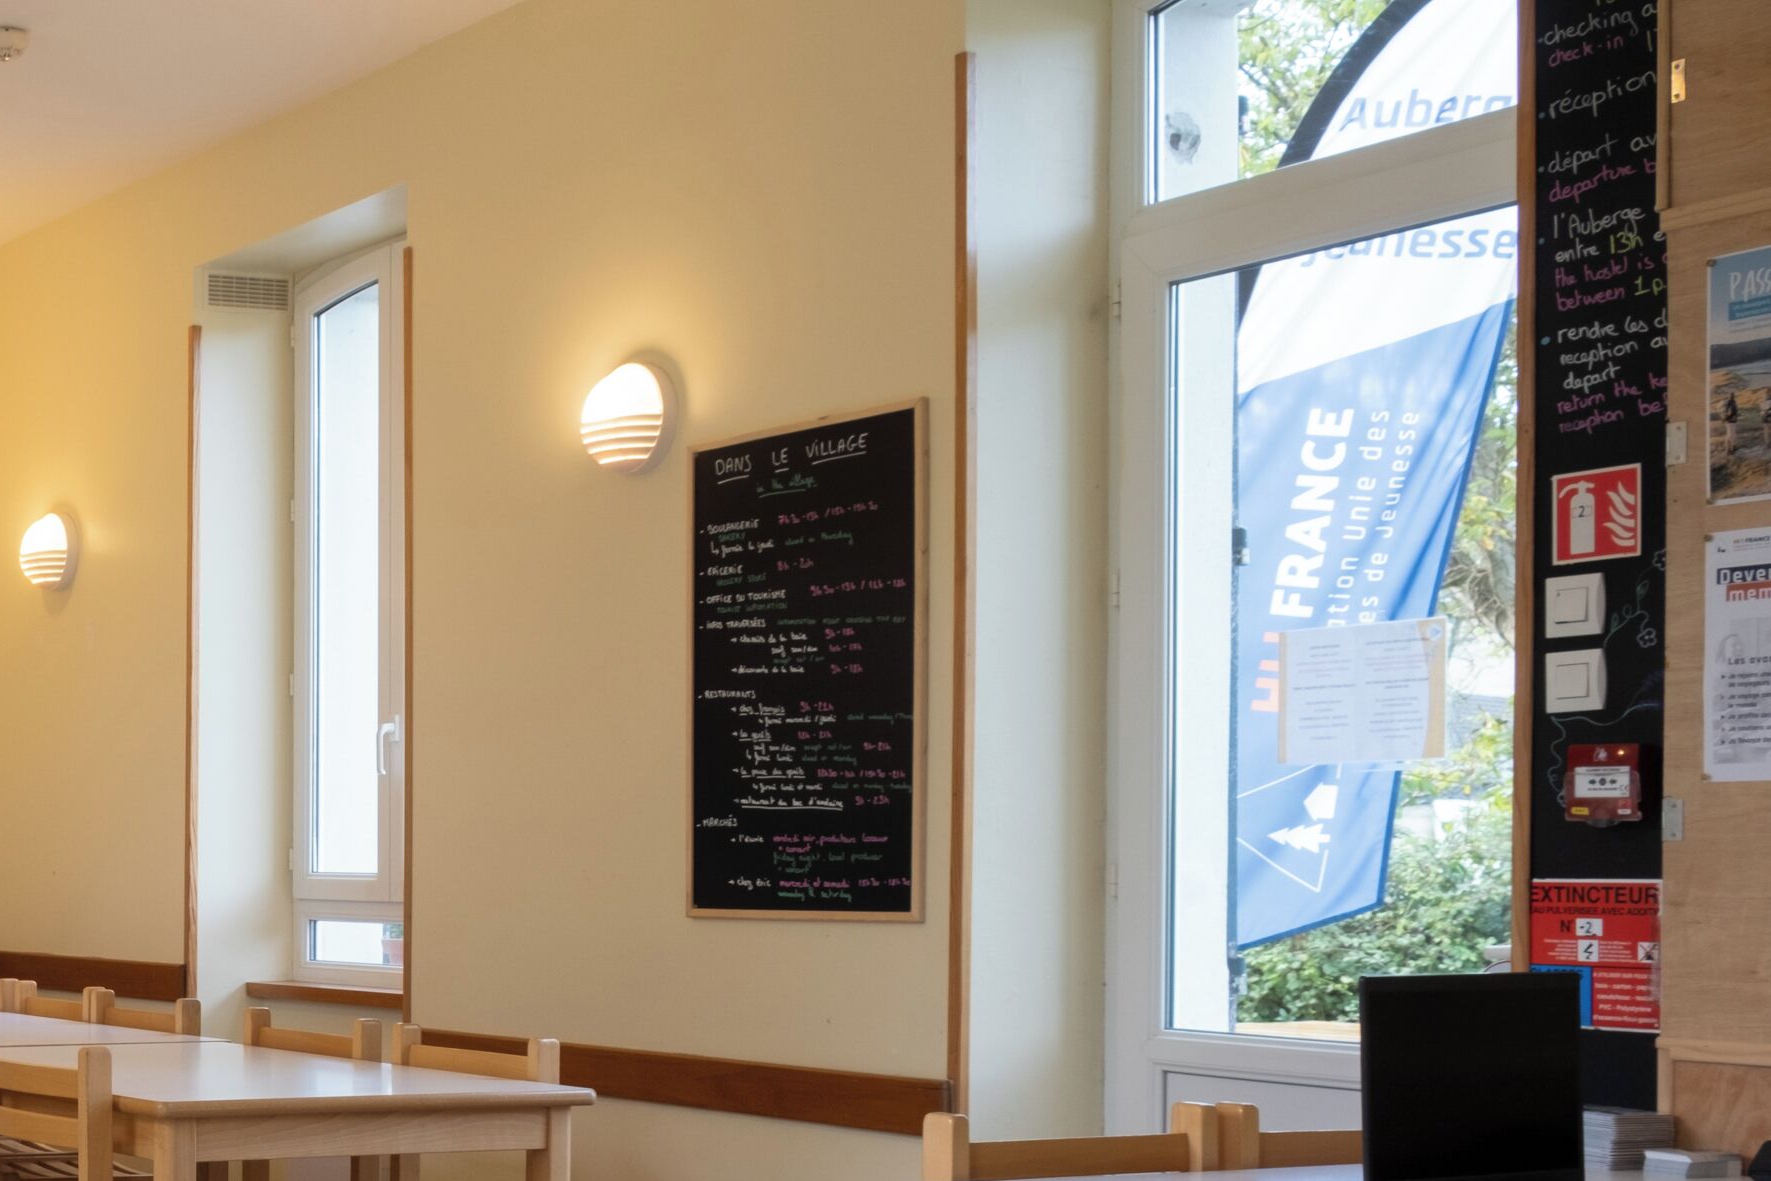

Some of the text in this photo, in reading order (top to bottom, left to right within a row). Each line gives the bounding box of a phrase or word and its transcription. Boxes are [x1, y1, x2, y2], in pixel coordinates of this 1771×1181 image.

[1544, 11, 1639, 45] checking
[1549, 36, 1623, 67] check-in
[1549, 71, 1657, 119] réception
[1548, 133, 1619, 174] départ
[1549, 164, 1636, 203] departure
[1553, 207, 1645, 239] l'Auberge
[1555, 237, 1600, 262] entre
[1555, 253, 1655, 288] the hostel is
[1556, 288, 1625, 311] between
[1557, 321, 1619, 343] rendre
[1625, 315, 1648, 332] les
[1560, 342, 1638, 370] reception
[1564, 361, 1621, 394] depart
[1557, 393, 1605, 414] return
[1614, 380, 1642, 397] the
[1359, 410, 1391, 461] des
[715, 454, 752, 475] DANS
[772, 447, 789, 466] LE
[1376, 411, 1420, 539] Jeunesse
[1269, 408, 1355, 618] FRANCE
[1342, 476, 1377, 540] Unie
[1578, 505, 1586, 518] 2
[1364, 552, 1389, 583] de
[1531, 886, 1660, 904] EXTINCTEUR
[1601, 907, 1627, 916] AVEC
